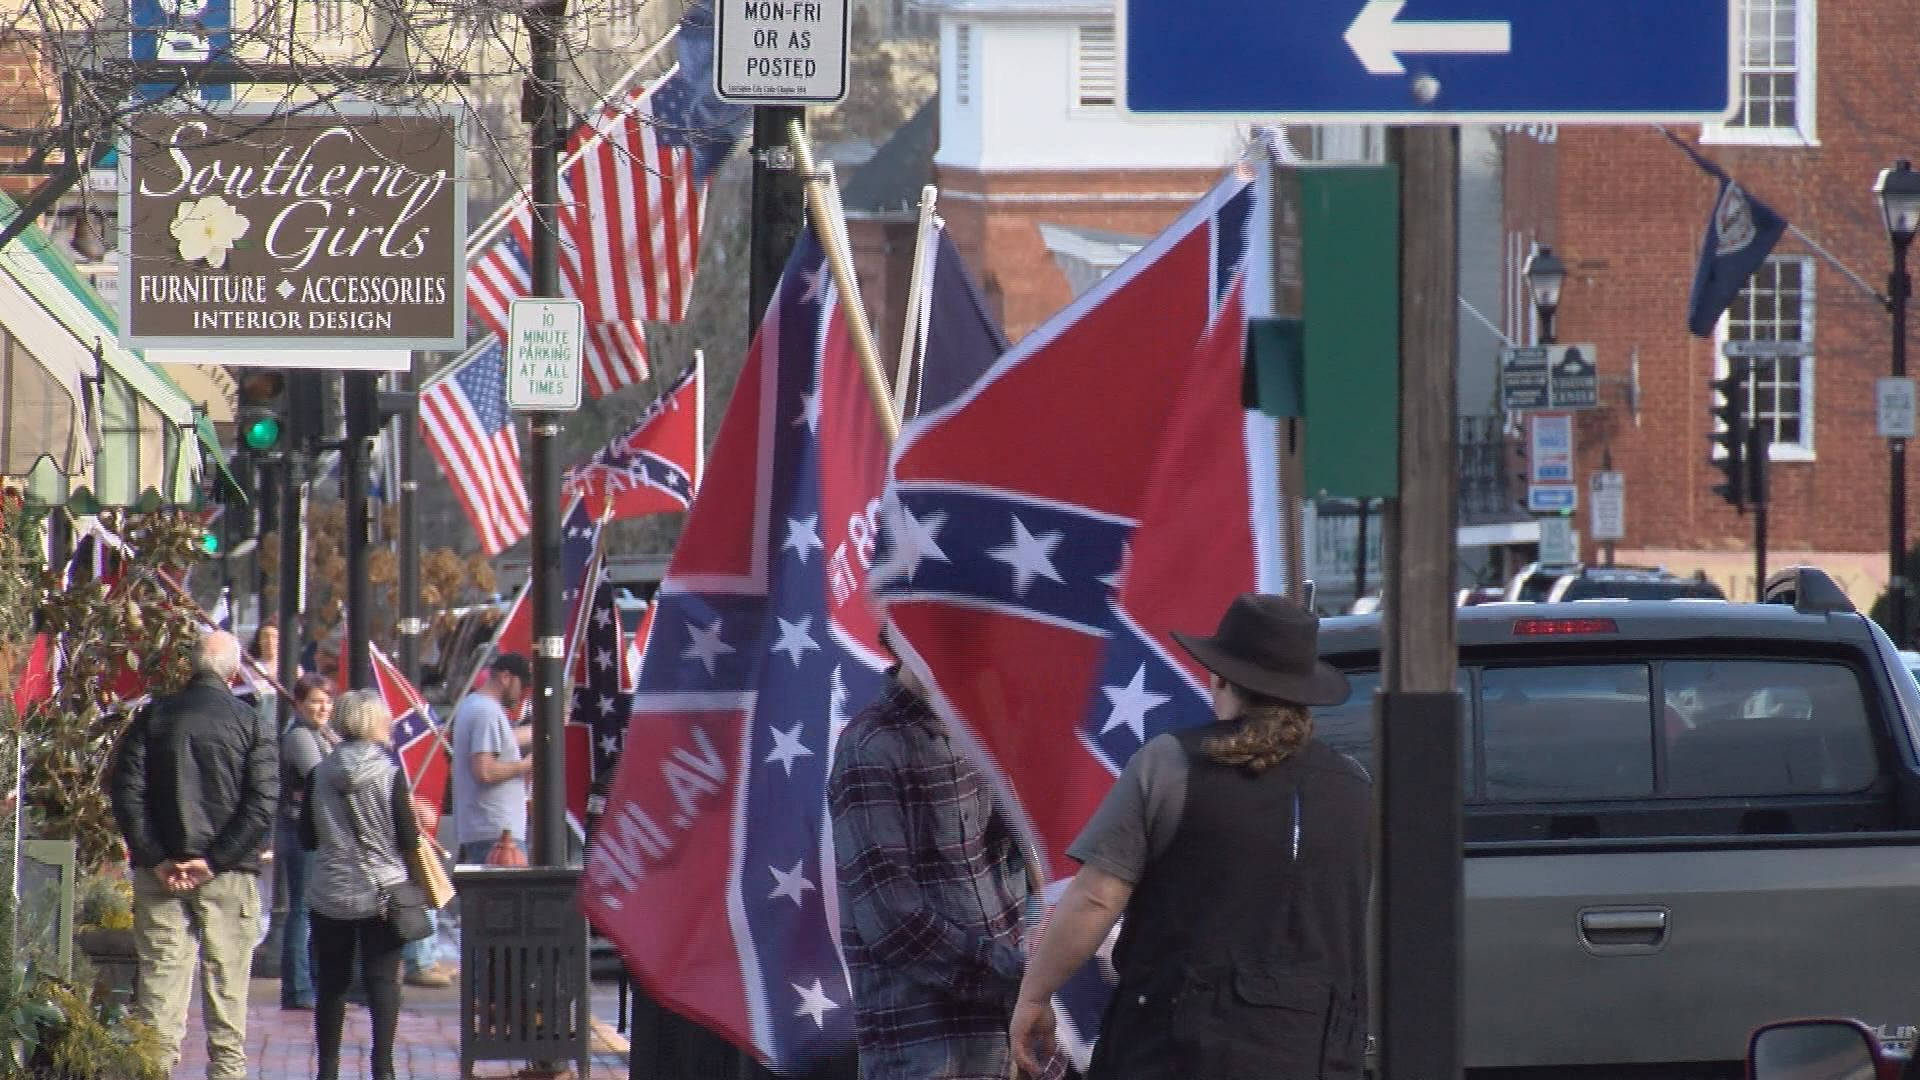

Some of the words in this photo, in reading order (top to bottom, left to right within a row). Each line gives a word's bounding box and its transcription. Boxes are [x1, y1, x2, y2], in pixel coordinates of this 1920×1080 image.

[745, 2, 821, 22] MON-FRI
[754, 30, 778, 48] OR
[788, 30, 811, 50] AS
[747, 58, 816, 77] POSTED
[139, 122, 423, 198] Southern
[265, 169, 447, 272] Girls
[140, 275, 267, 303] FURNITURE
[301, 275, 446, 303] ACCESSORIES
[193, 311, 302, 329] INTERIOR
[309, 311, 392, 330] DESIGN
[543, 314, 554, 327] 10
[523, 330, 568, 344] MINUTE
[519, 345, 570, 360] PARKING
[520, 363, 536, 377] AT
[545, 363, 569, 378] ALL
[529, 380, 564, 394] TIMES
